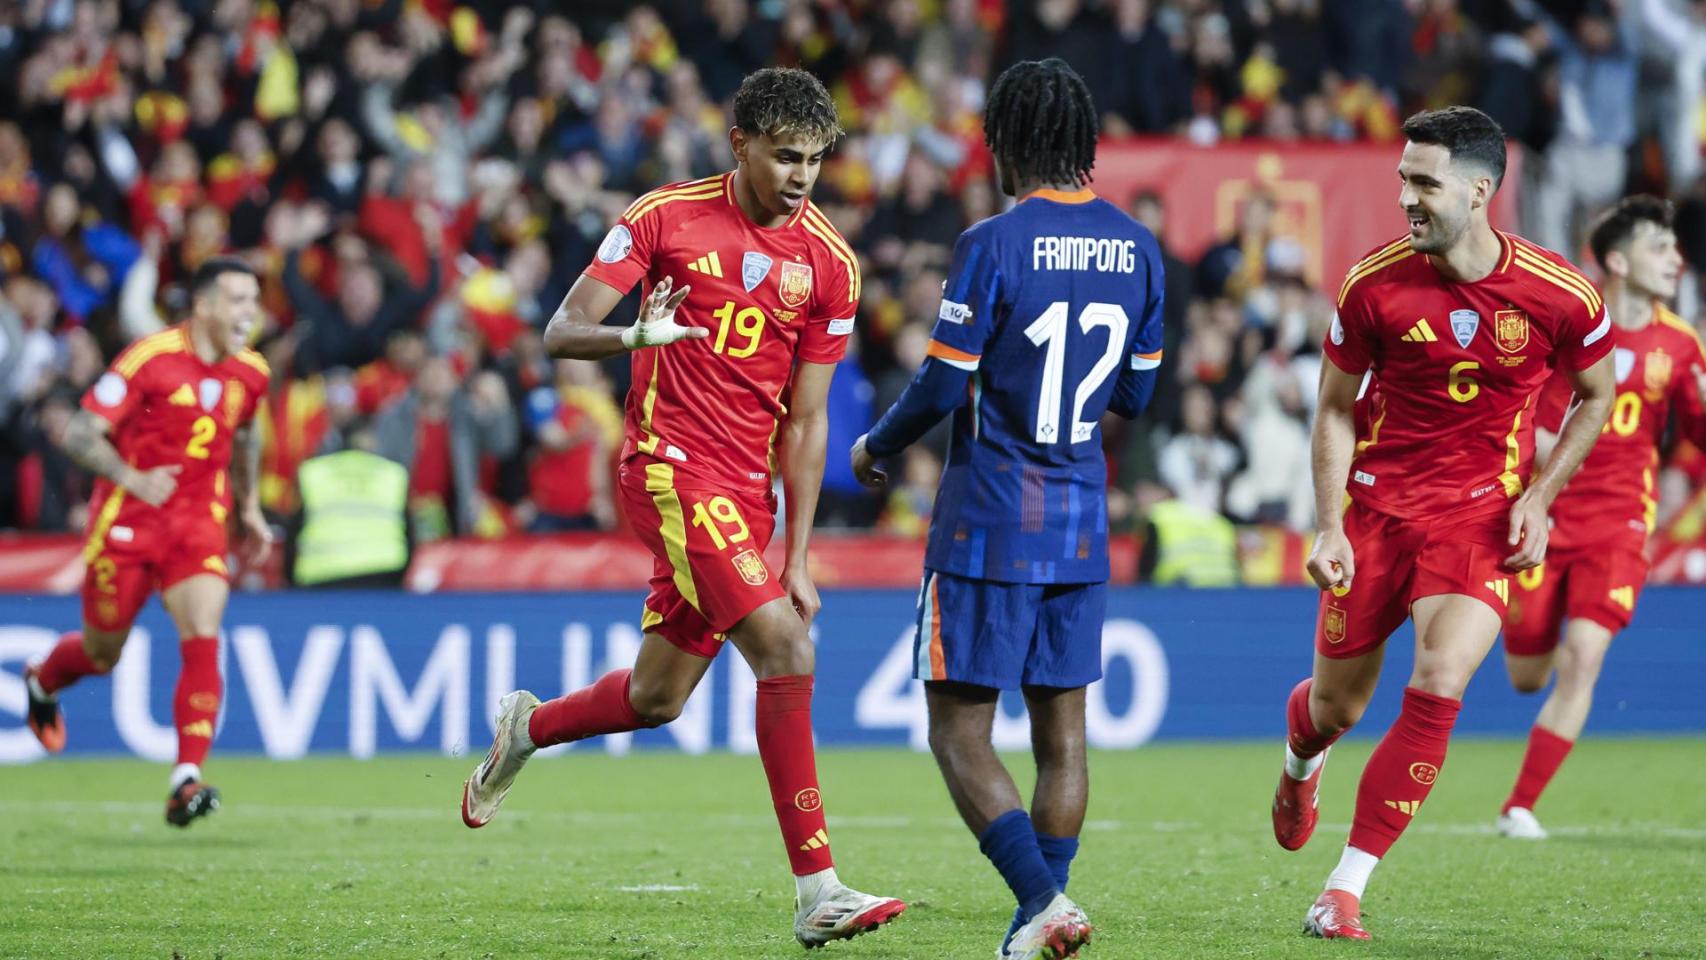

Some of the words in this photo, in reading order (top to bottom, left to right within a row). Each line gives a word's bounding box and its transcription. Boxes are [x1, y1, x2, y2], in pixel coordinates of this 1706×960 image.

[1033, 236, 1136, 274] FRIMPONG
[712, 301, 766, 359] 19
[1024, 301, 1130, 444] 12
[1448, 361, 1480, 403] 6
[185, 415, 217, 459] 2
[1601, 391, 1642, 437] 0
[692, 496, 749, 550] 19
[853, 619, 1170, 752] 40
